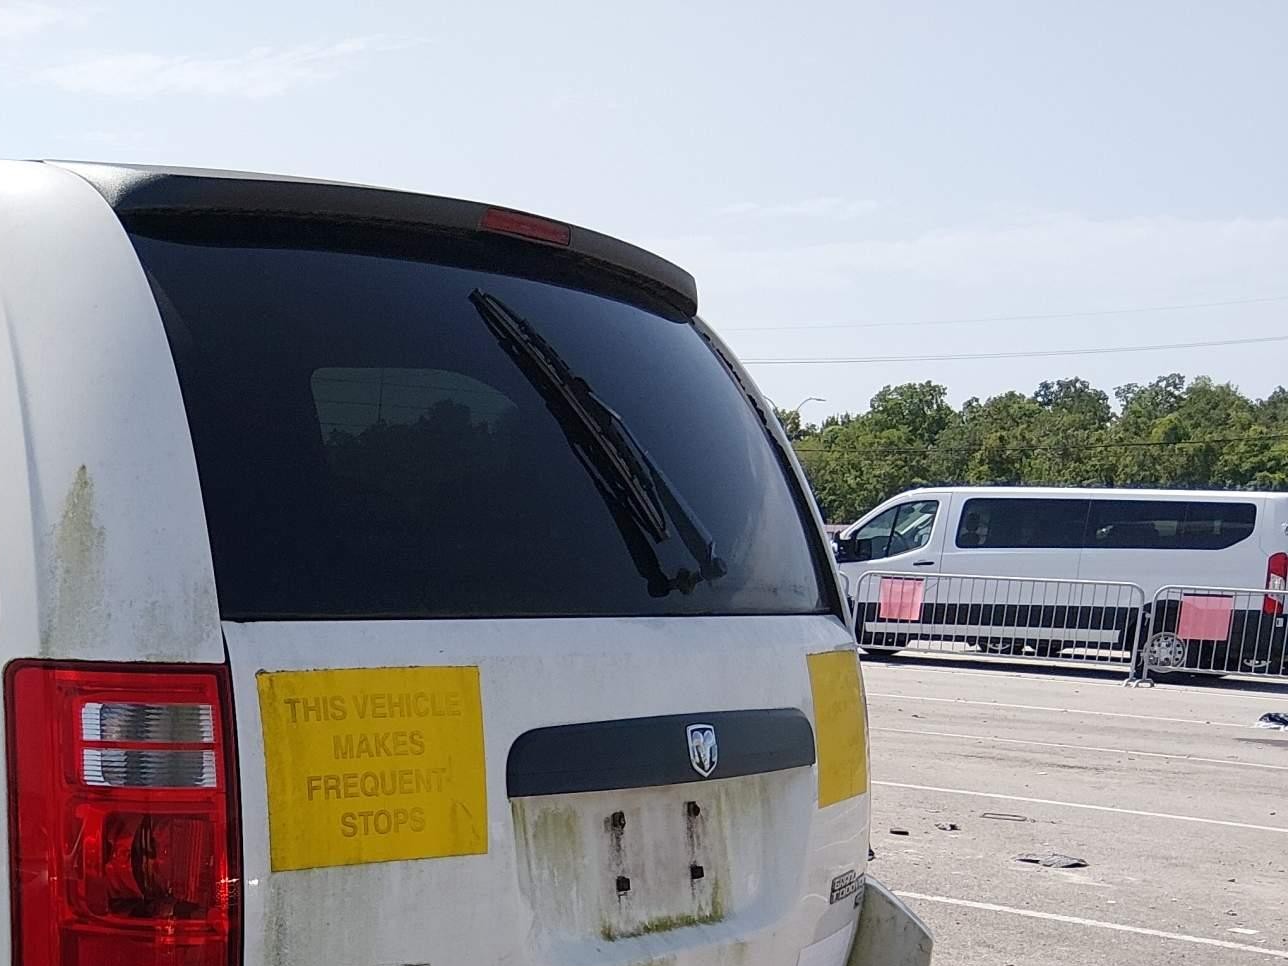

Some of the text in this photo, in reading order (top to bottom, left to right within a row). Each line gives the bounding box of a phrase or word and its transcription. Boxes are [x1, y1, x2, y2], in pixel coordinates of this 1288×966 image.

[284, 690, 463, 724] THIS VEHICLE
[332, 730, 426, 760] MAKES
[306, 766, 447, 802] FREQUENT
[340, 807, 426, 839] STOPS
